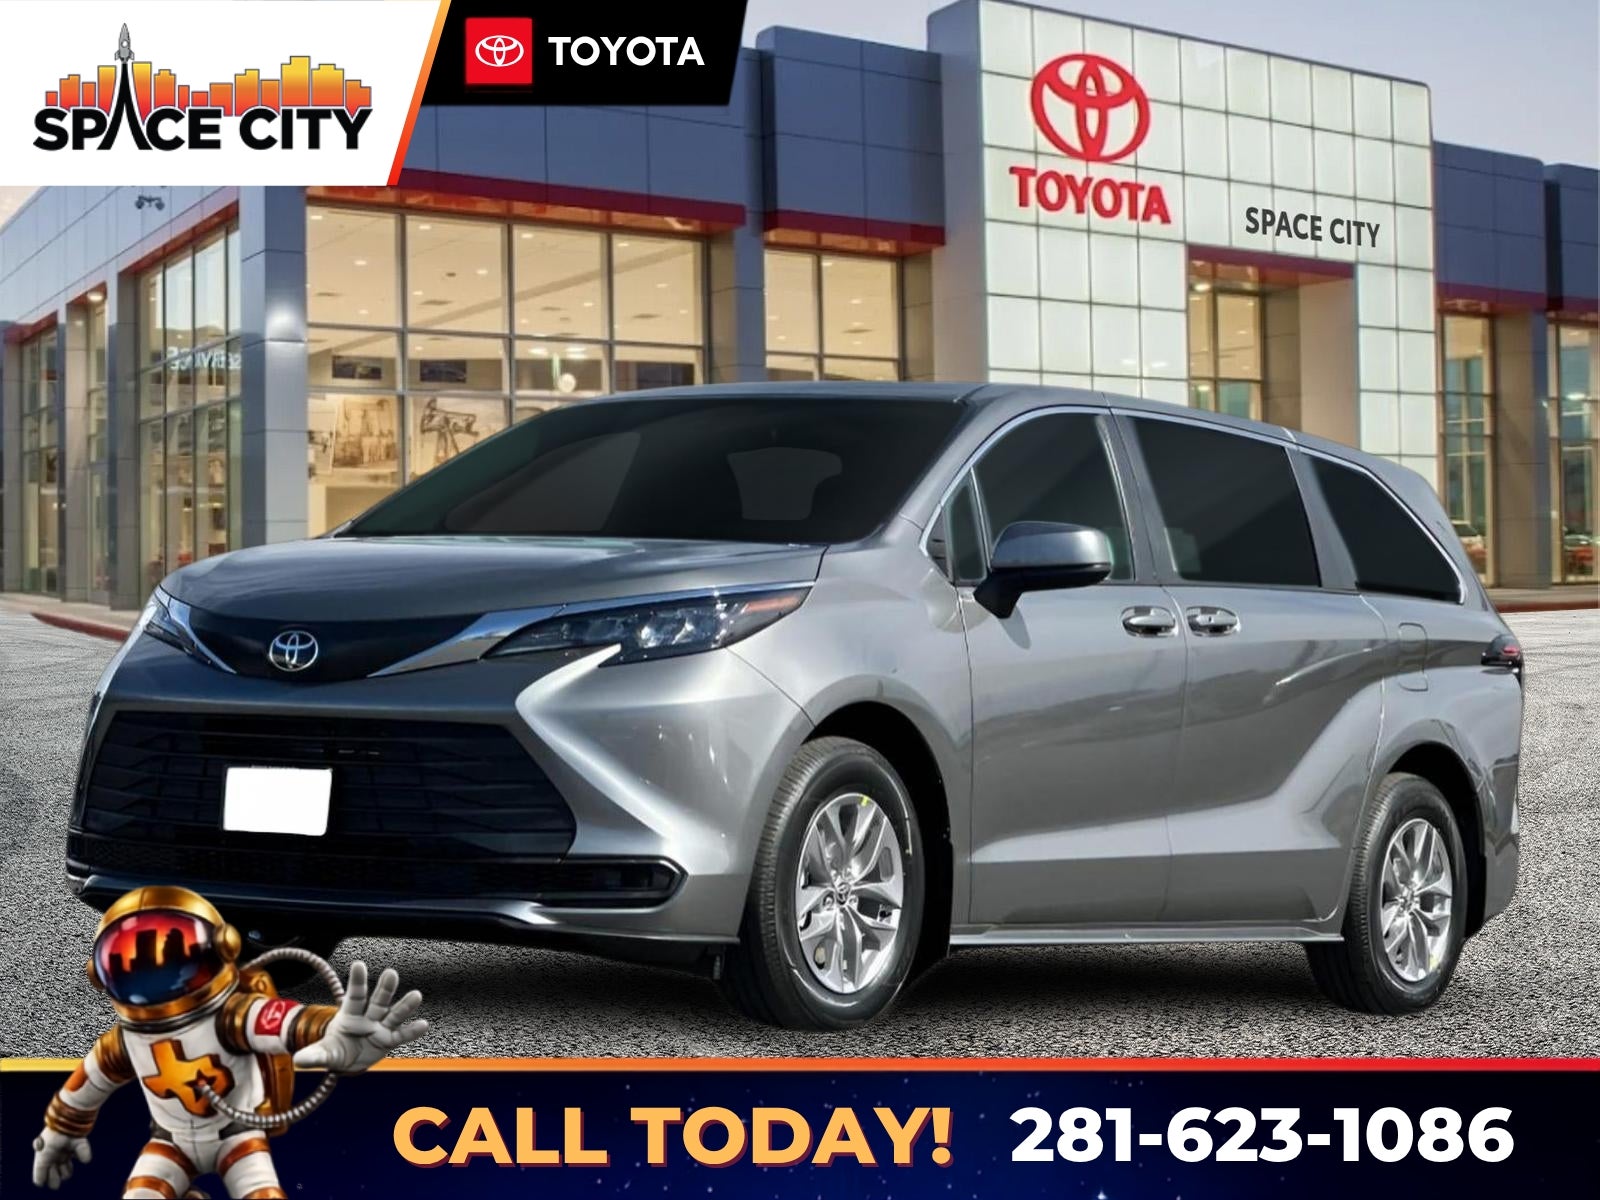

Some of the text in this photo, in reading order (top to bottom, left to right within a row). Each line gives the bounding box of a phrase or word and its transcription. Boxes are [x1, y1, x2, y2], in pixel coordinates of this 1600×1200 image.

[1009, 166, 1171, 224] TOYOTA
[1245, 206, 1380, 247] SPACE CITY
